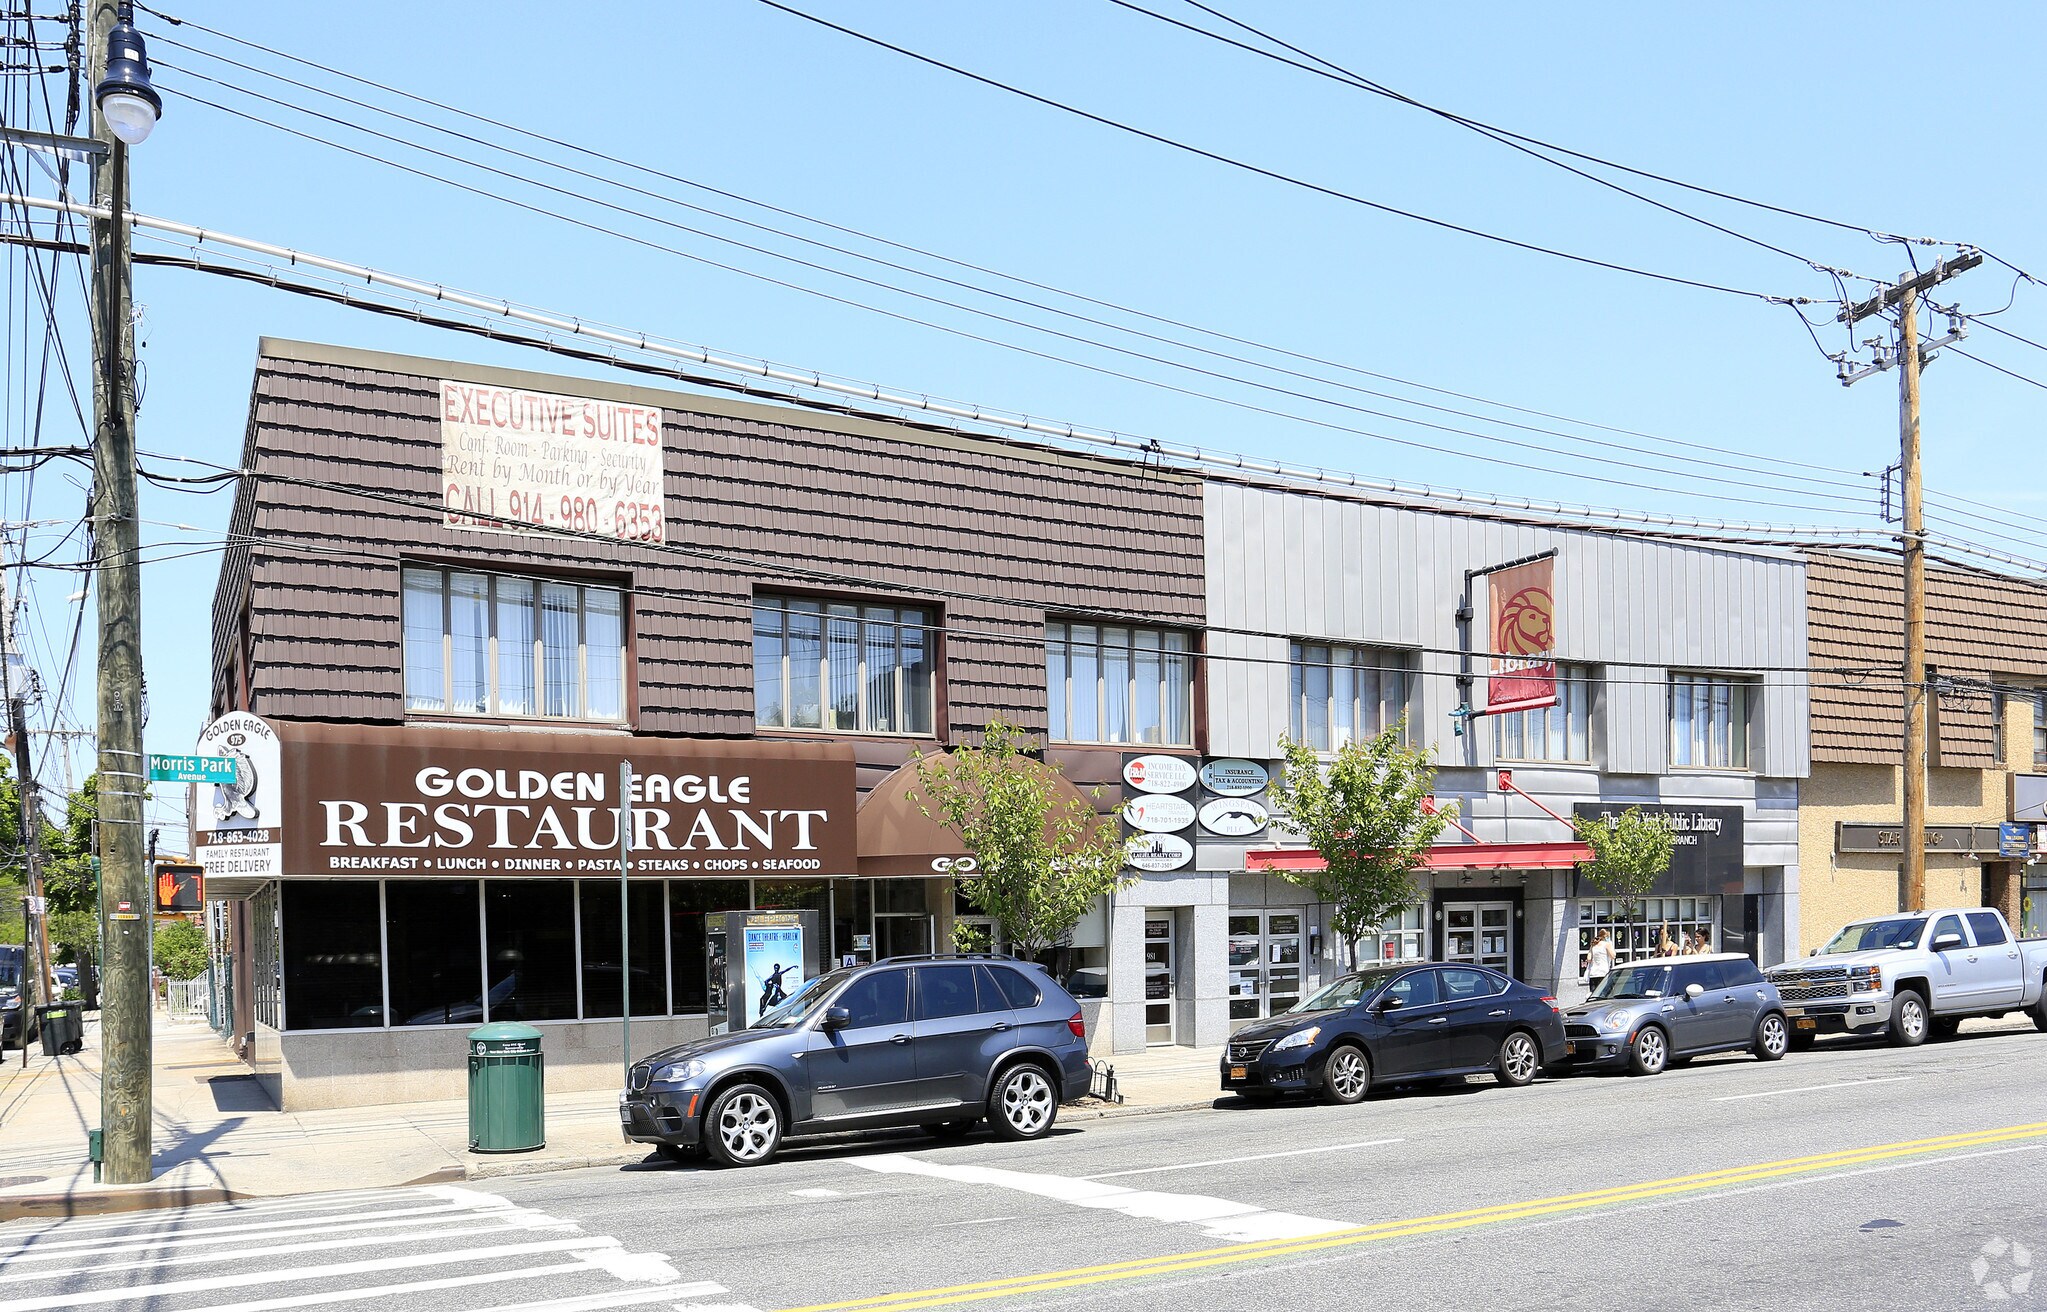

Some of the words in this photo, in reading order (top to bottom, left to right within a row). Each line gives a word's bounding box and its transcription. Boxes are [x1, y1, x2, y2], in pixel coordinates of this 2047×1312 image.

[444, 384, 576, 436] EXECUTIVE
[583, 401, 659, 447] SUITES
[459, 431, 489, 453] Conf.
[495, 436, 528, 457] Room
[541, 441, 588, 465] Parking
[600, 448, 646, 472] Security
[446, 454, 485, 477] Rent
[493, 457, 512, 487] by
[518, 464, 571, 486] Month
[577, 474, 593, 488] or
[599, 469, 619, 504] by
[625, 474, 659, 498] Year
[445, 483, 503, 528] CALL
[509, 489, 544, 530] 914
[560, 495, 598, 534] 980
[615, 500, 662, 543] 6353
[1488, 649, 1555, 675] Library
[205, 719, 241, 742] GOLDEN
[243, 719, 271, 741] EAGLE
[230, 736, 244, 745] 975
[150, 757, 195, 771] Morris
[201, 758, 232, 773] Park
[1148, 762, 1172, 770] INCOME
[1174, 763, 1187, 771] TAX
[177, 772, 207, 781] Avenue
[415, 766, 606, 801] GOLDEN
[629, 773, 750, 804] EAGLE
[1147, 771, 1173, 779] SERVICE
[1175, 772, 1187, 780] LLC
[318, 800, 828, 850] RESTAURANT
[1601, 811, 1619, 830] The
[1691, 812, 1722, 836] Library
[207, 829, 270, 844] 718-863-4028
[206, 849, 227, 858] FAMILY
[230, 847, 270, 858] RESTAURANT
[205, 861, 225, 873] FREE
[228, 859, 272, 873] DELIVERY
[329, 856, 419, 869] BREAKFAST
[437, 857, 487, 870] LUNCH
[504, 858, 561, 871] DINNER
[577, 859, 622, 871] PASTA
[637, 859, 689, 872] STEAKS
[704, 859, 748, 871] CHOPS
[762, 858, 821, 871] SEAFOOD
